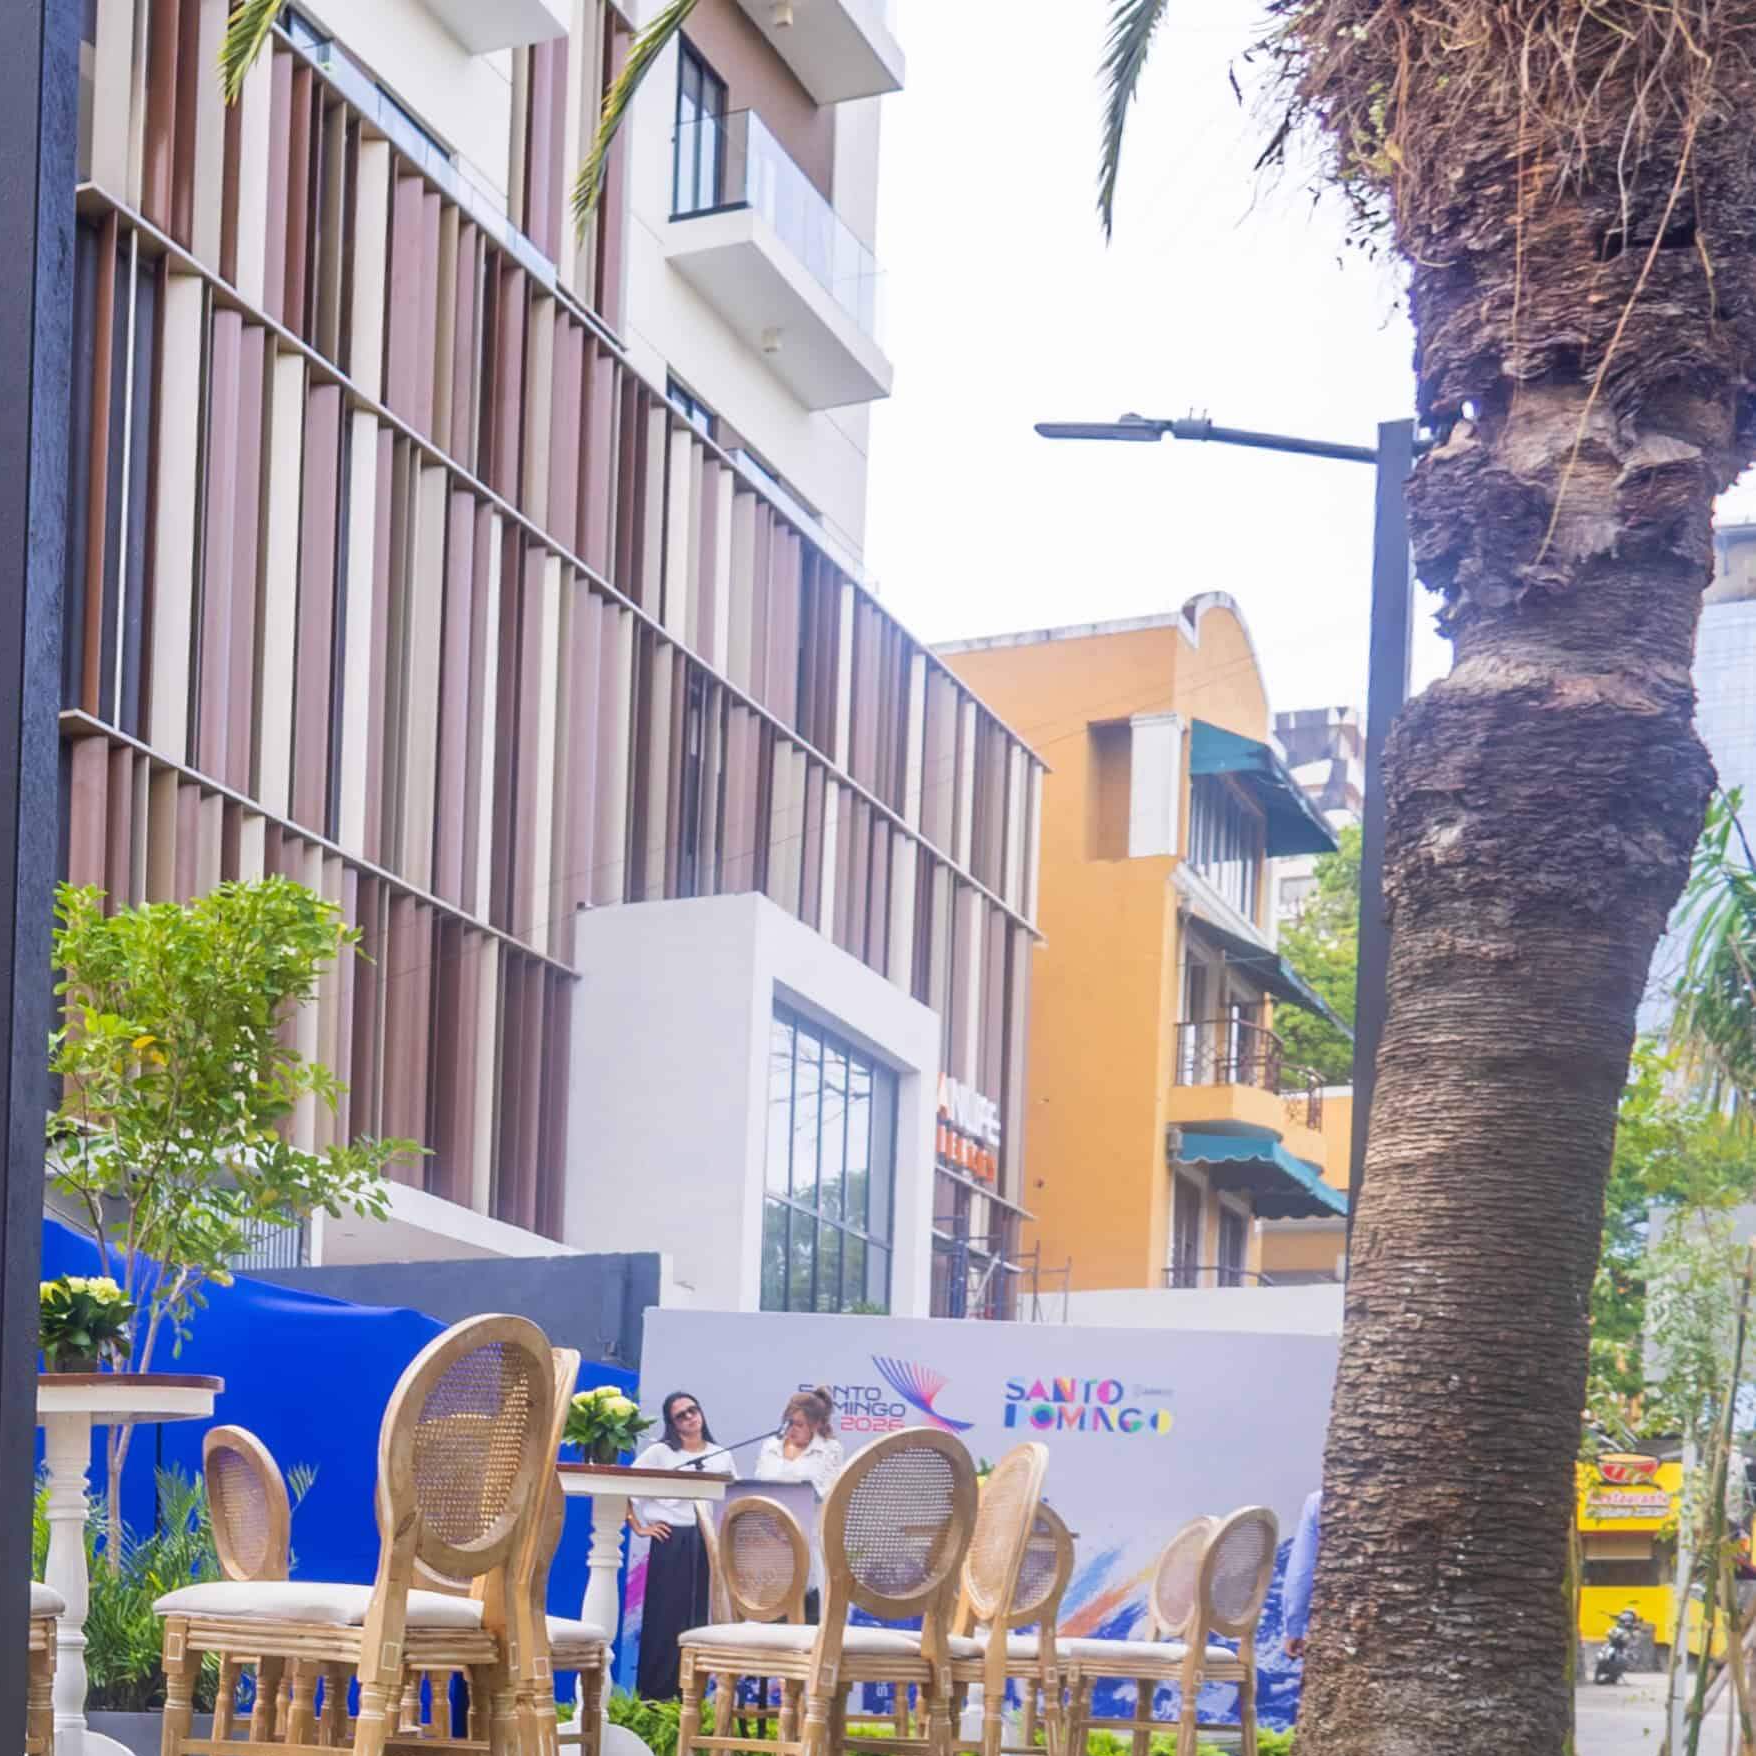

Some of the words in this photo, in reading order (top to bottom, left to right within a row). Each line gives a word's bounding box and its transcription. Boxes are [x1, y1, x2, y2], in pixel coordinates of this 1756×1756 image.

[1005, 1376, 1125, 1405] SANTO
[833, 1401, 905, 1416] MINGO
[1004, 1403, 1173, 1434] DOMINGO
[841, 1416, 905, 1432] 2026
